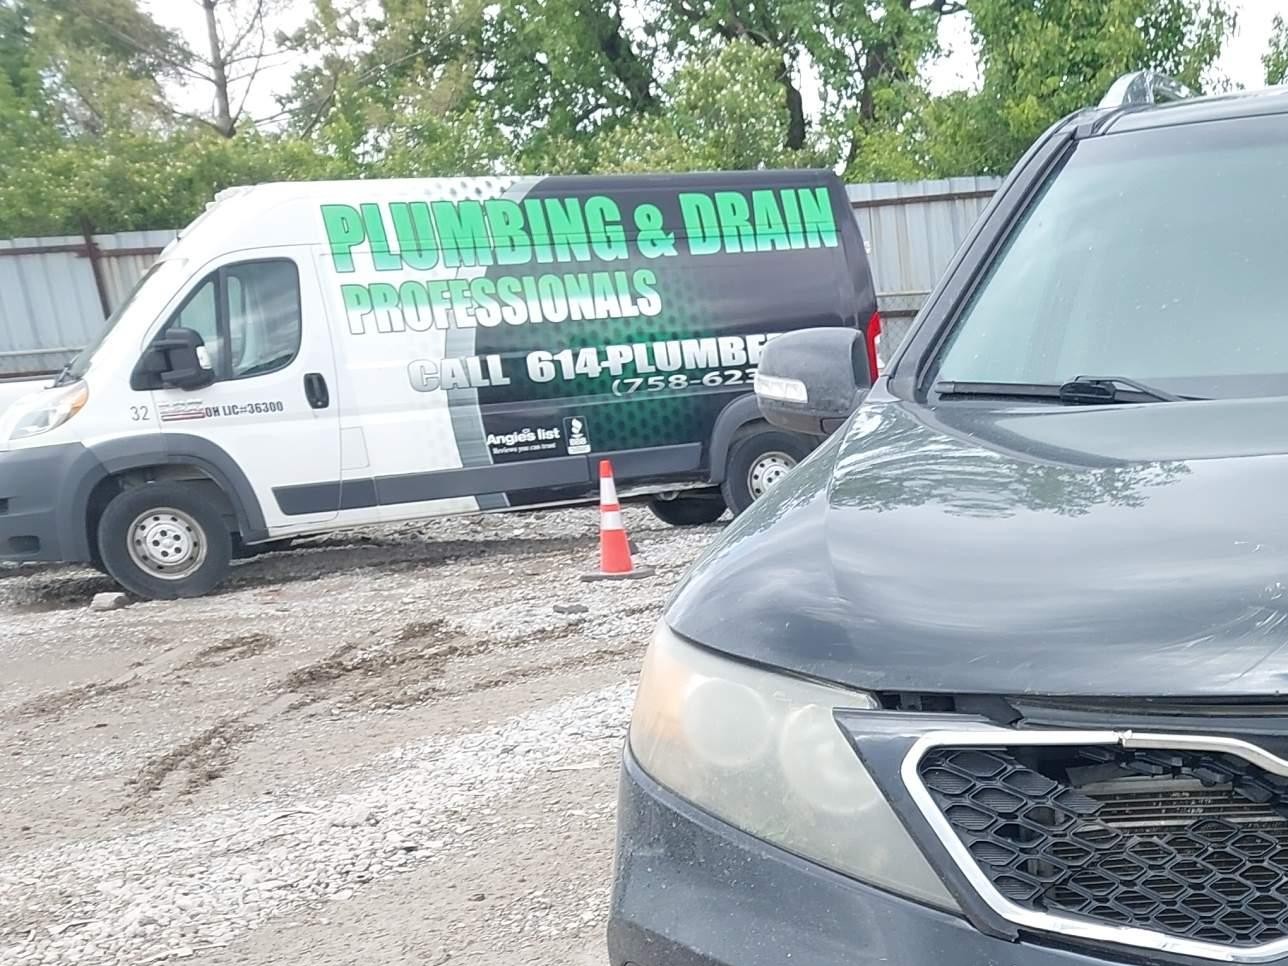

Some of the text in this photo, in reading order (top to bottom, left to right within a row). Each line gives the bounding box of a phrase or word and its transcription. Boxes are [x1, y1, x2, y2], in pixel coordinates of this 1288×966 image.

[320, 186, 839, 273] PLUMBING & DRAIN
[340, 268, 662, 335] PROFESSIONALS
[407, 333, 784, 393] CALL 614-PLUMBE
[130, 405, 150, 421] 32
[537, 427, 560, 441] list
